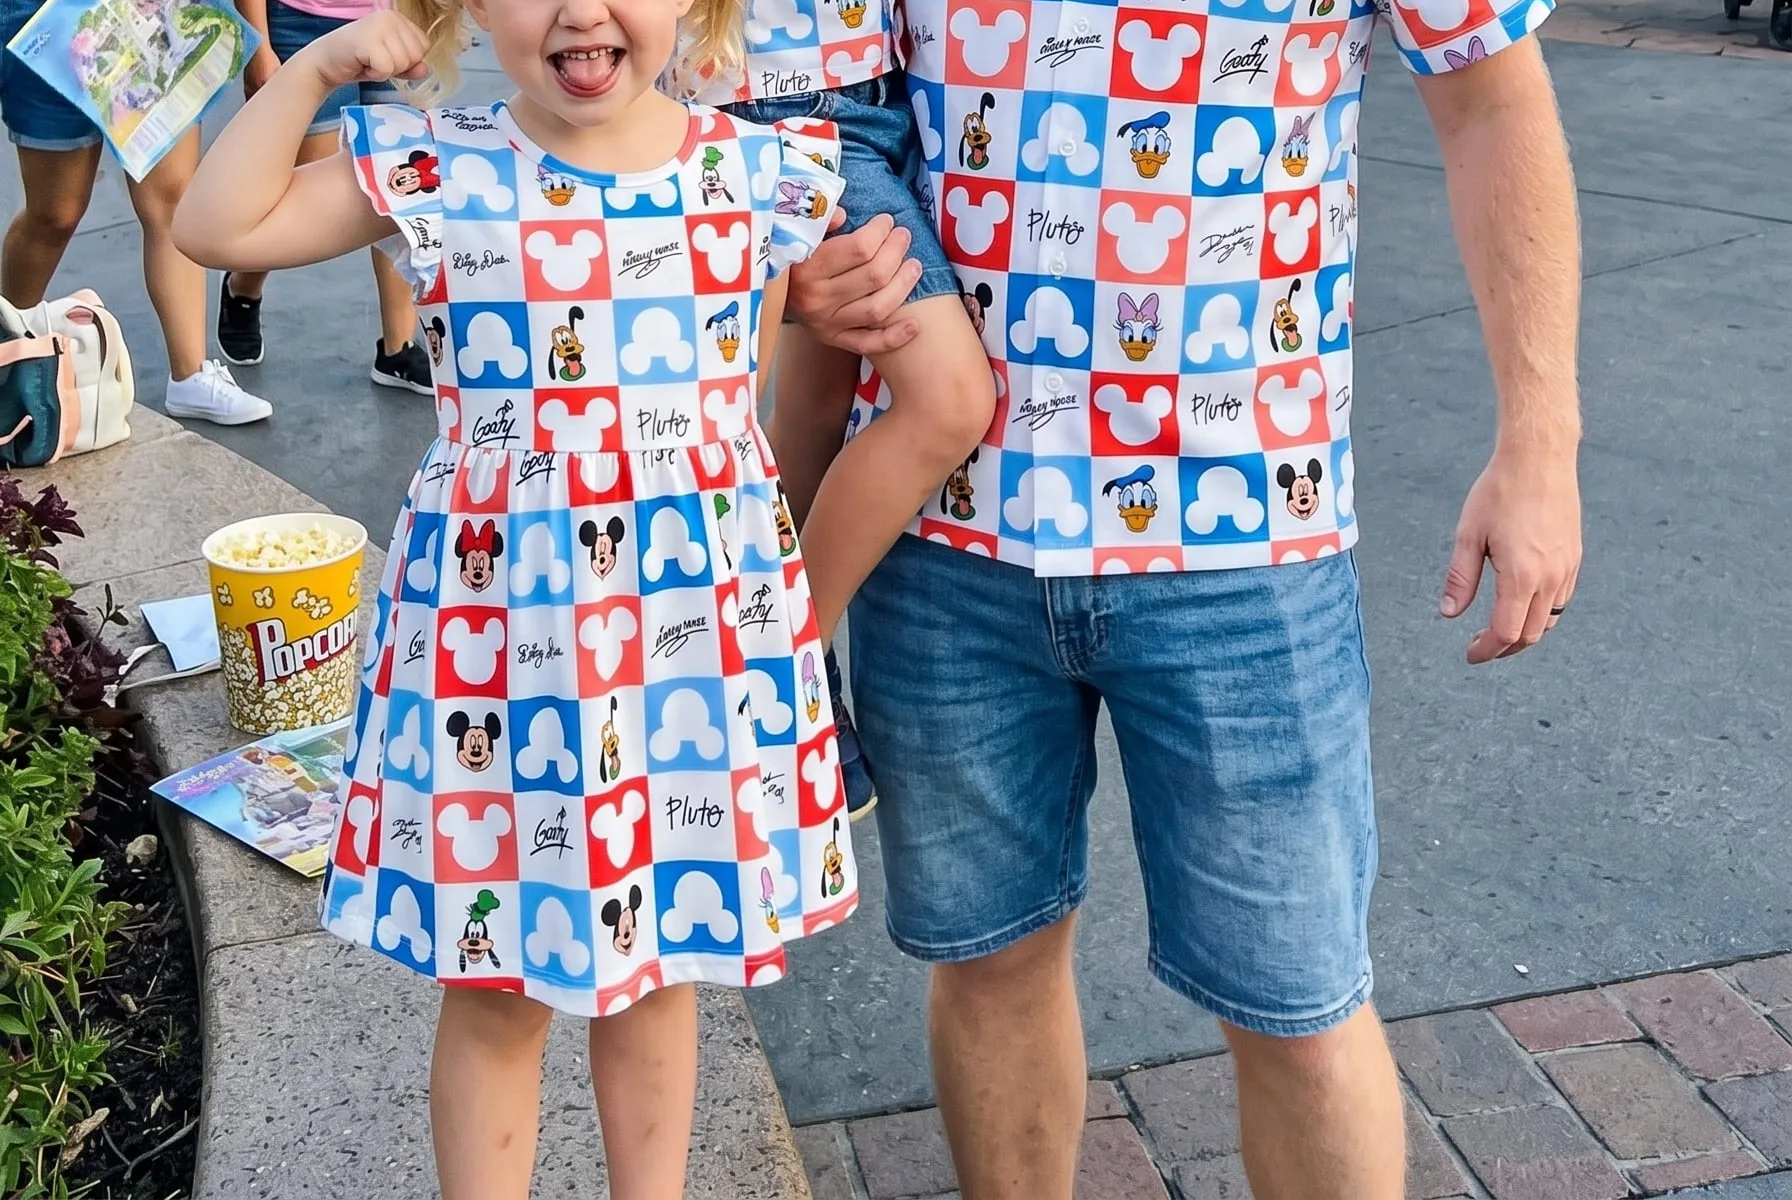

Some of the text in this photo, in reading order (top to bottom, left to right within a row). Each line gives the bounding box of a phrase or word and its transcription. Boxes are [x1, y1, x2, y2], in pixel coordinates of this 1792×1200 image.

[762, 70, 812, 97] Pluto
[1027, 208, 1085, 245] Pluto
[639, 408, 691, 441] Pluto
[1191, 392, 1243, 426] Pluto
[665, 795, 724, 831] Pluto
